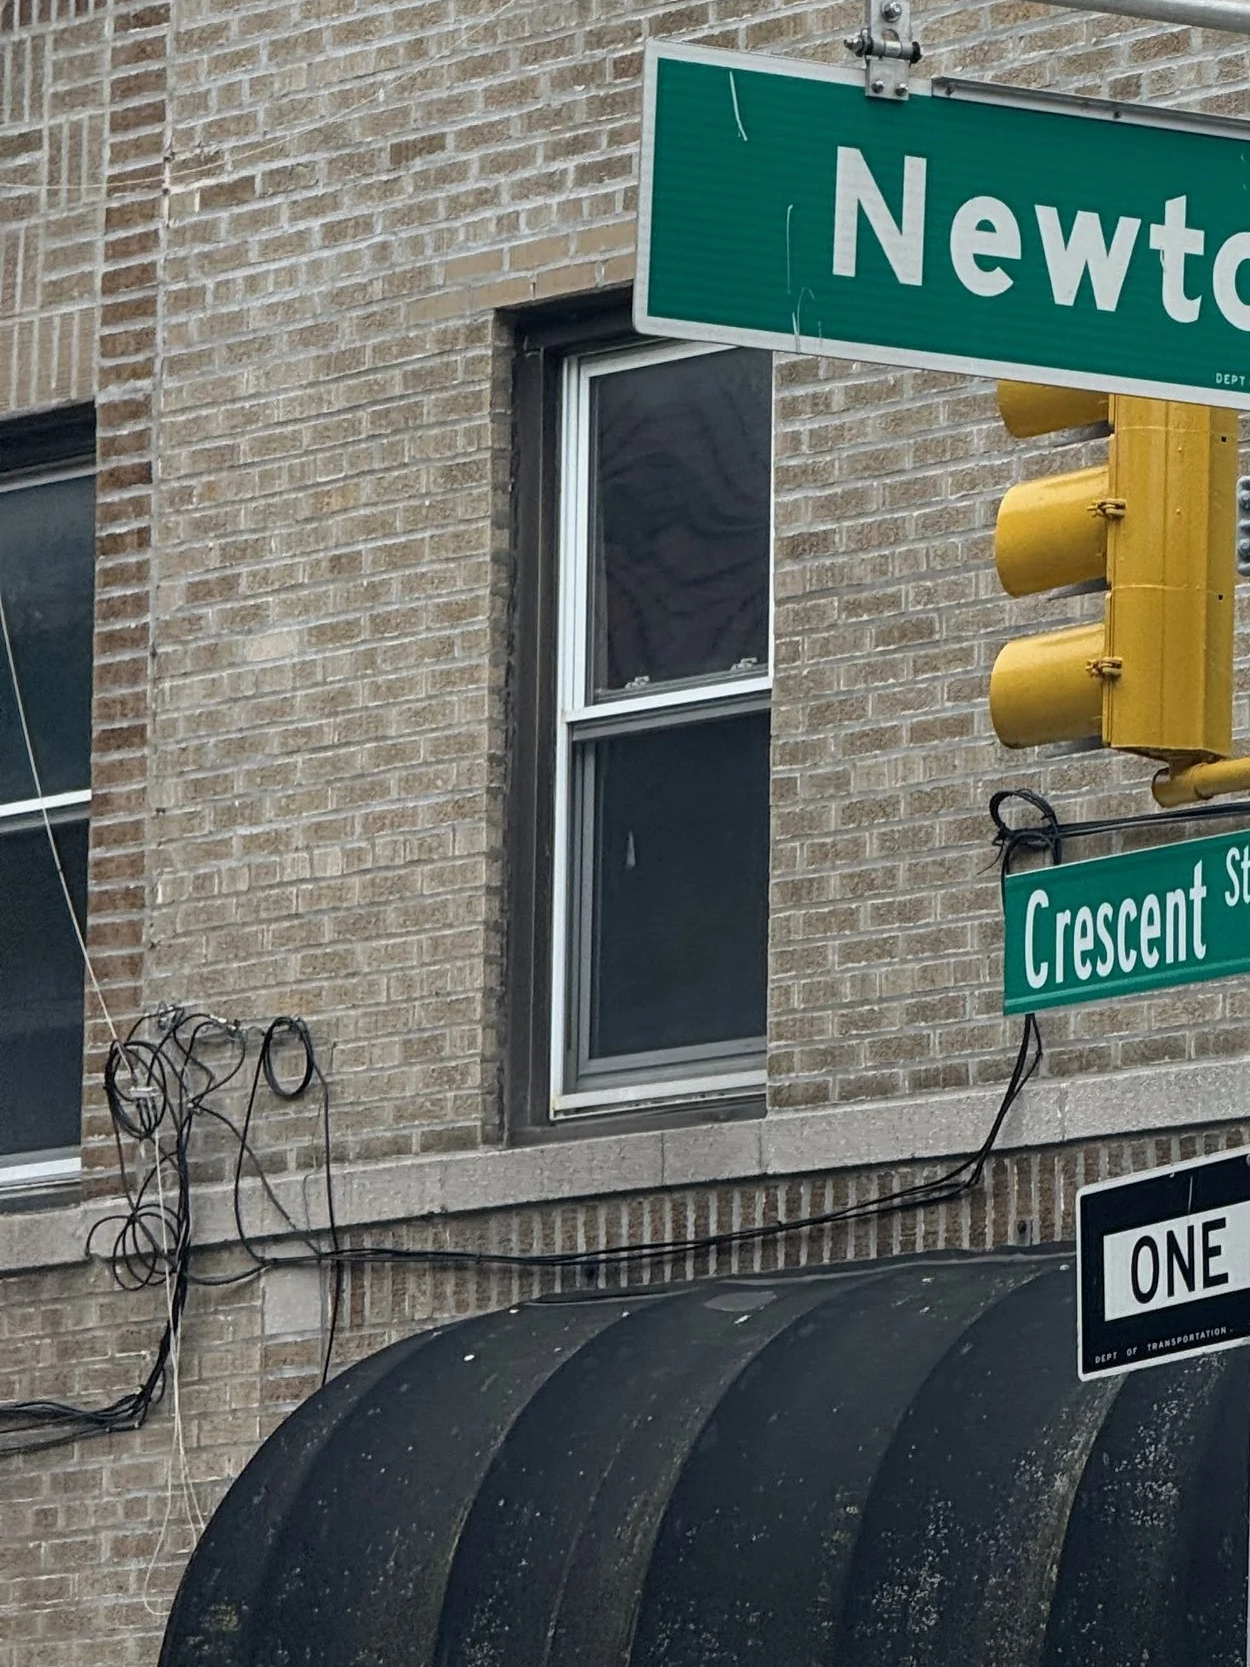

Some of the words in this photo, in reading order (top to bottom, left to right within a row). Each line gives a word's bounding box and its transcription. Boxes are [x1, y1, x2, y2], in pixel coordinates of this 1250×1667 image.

[1215, 372, 1246, 387] DEPT
[1025, 860, 1207, 989] Crescent
[1131, 1217, 1229, 1304] ONE
[1095, 1351, 1118, 1364] DEPT
[1126, 1346, 1138, 1357] OF
[1147, 1326, 1227, 1352] TRANSPORTATION
